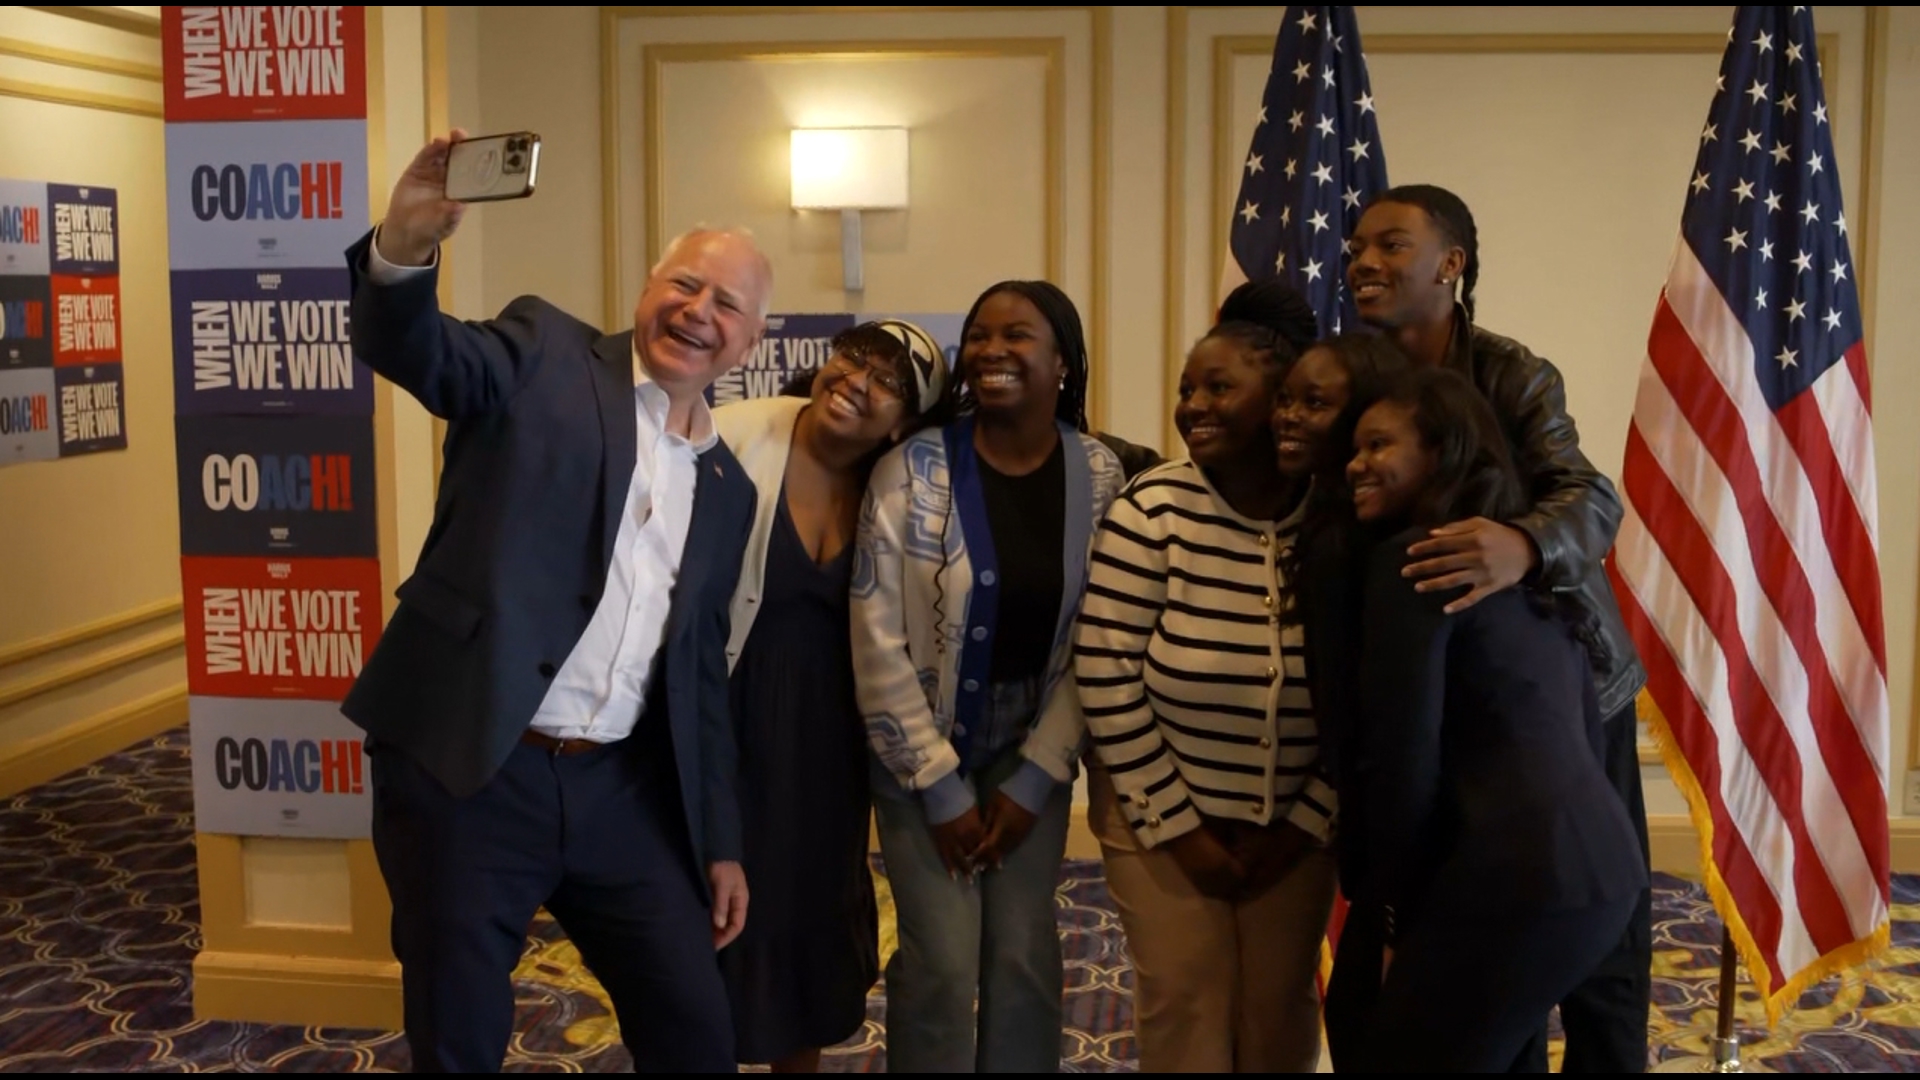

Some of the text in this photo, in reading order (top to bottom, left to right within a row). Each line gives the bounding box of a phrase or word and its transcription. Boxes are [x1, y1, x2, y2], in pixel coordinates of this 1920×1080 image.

[222, 6, 343, 49] WE VOTE
[181, 7, 222, 99] WHEN
[222, 48, 345, 97] WE WIN
[191, 162, 343, 221] COACH!
[0, 204, 39, 244] ACH!
[54, 203, 72, 261] WHEN
[70, 204, 112, 233] WE VOTE
[72, 232, 114, 261] WE WIN
[59, 294, 74, 352] WHEN
[73, 294, 115, 321] WE VOTE
[231, 300, 351, 343] WE VOTE
[75, 321, 116, 351] WE WIN
[191, 301, 231, 391] WHEN
[234, 344, 353, 390] WE WIN
[61, 385, 78, 443] WHEN
[76, 381, 118, 411] WE VOTE
[78, 408, 120, 440] WE WIN
[202, 453, 353, 511] COACH!
[203, 587, 242, 675] WHEN
[241, 588, 361, 632] WE VOTE
[243, 631, 363, 678] WE WIN
[215, 737, 364, 794] COACH!
